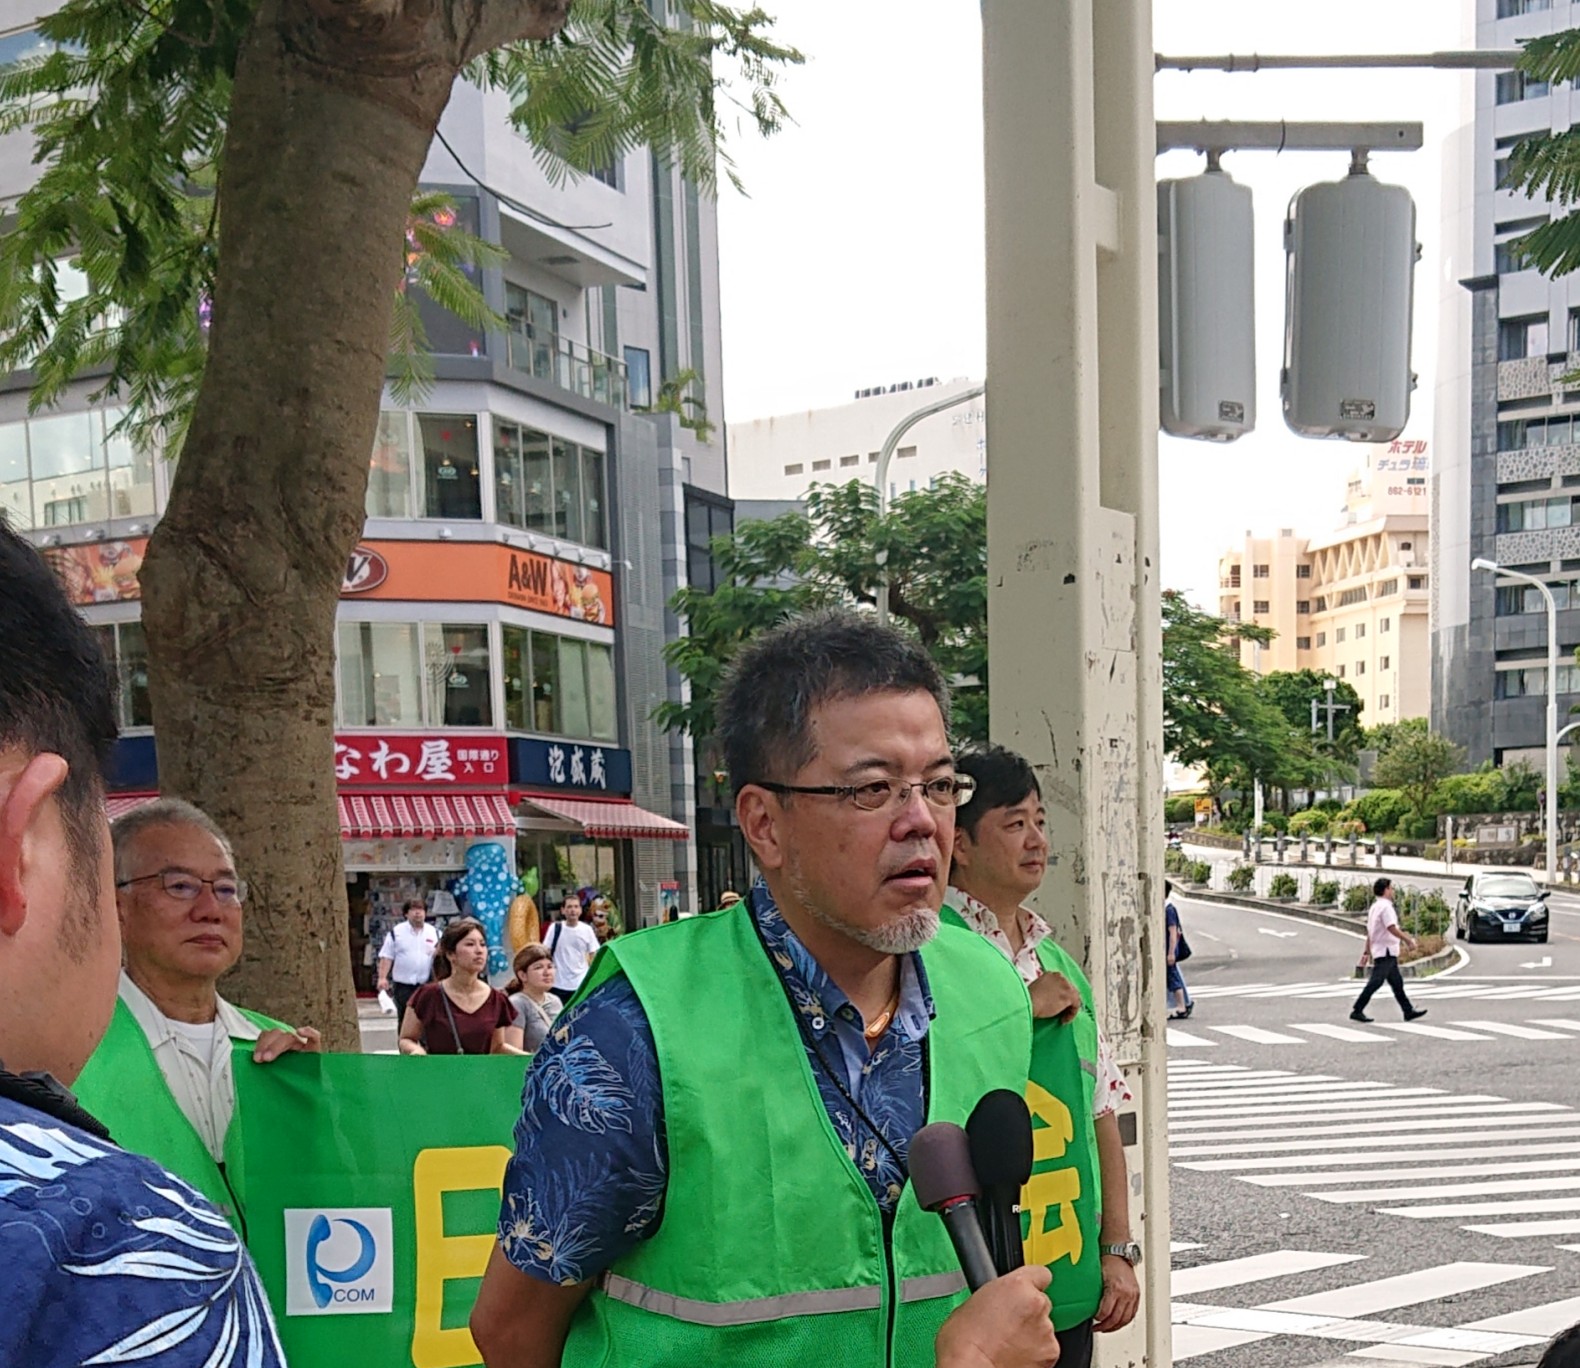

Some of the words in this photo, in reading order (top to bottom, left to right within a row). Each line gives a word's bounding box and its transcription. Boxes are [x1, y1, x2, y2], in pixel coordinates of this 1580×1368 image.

[1387, 440, 1428, 454] ホテル
[508, 554, 548, 597] A&W
[334, 738, 456, 780] なわ屋
[333, 1288, 375, 1303] COM
